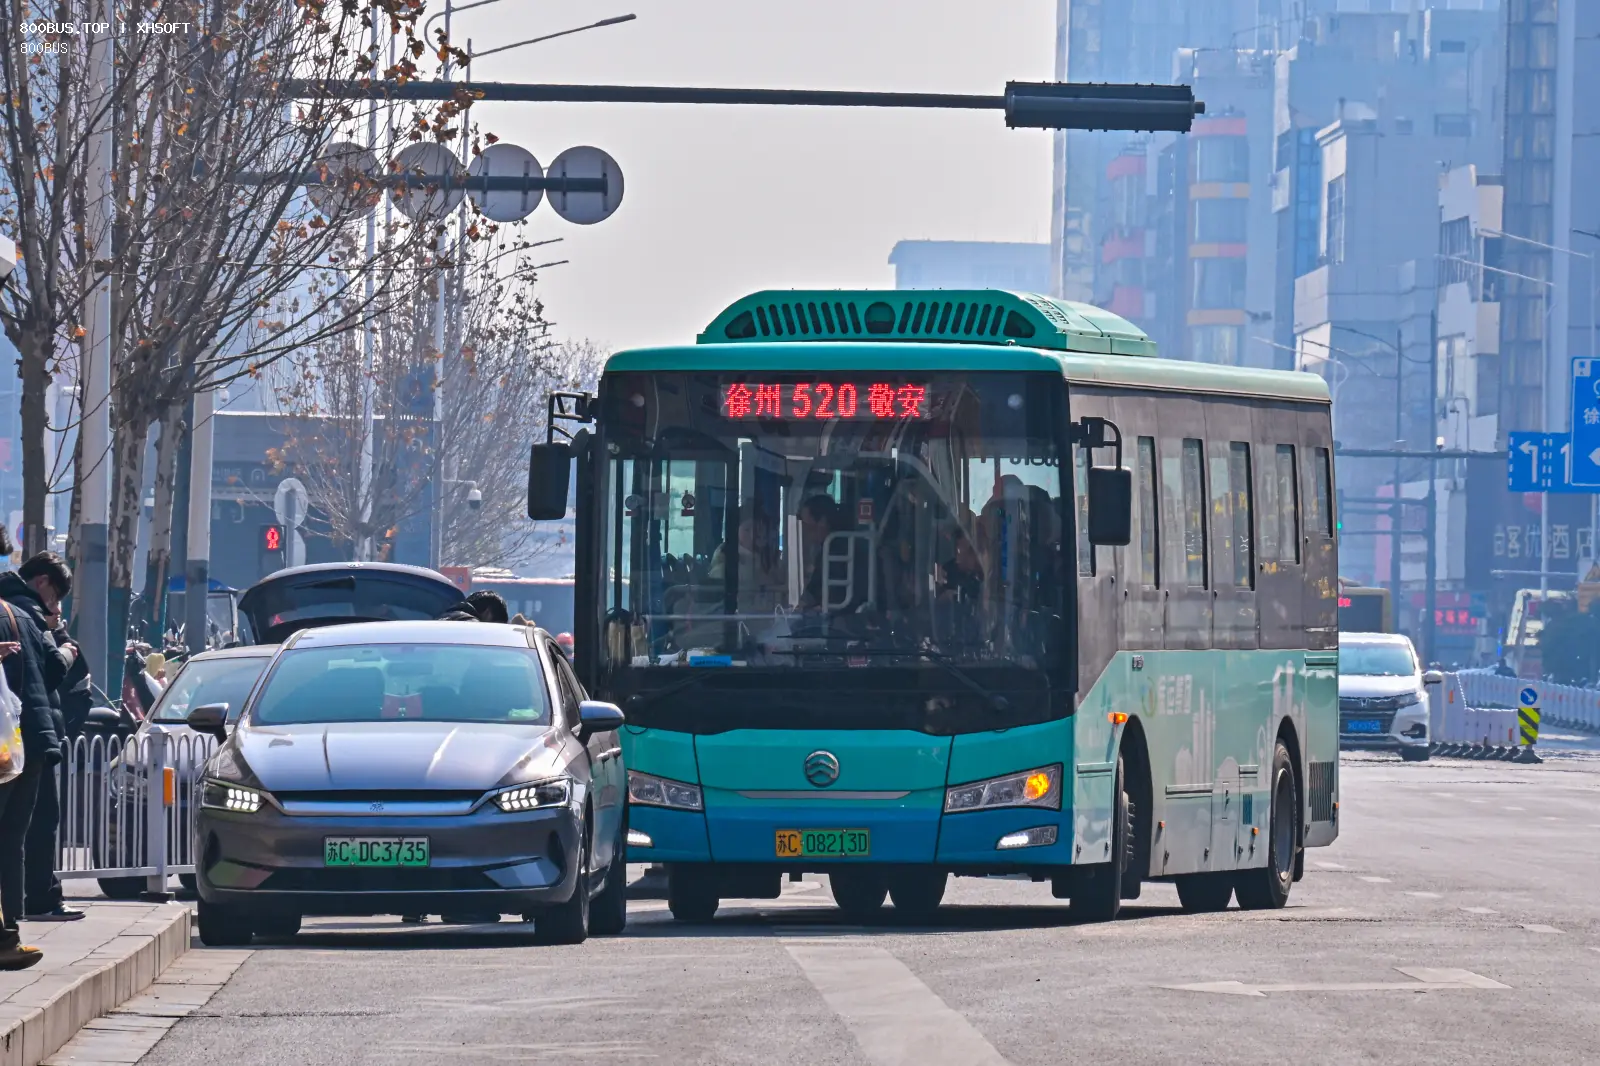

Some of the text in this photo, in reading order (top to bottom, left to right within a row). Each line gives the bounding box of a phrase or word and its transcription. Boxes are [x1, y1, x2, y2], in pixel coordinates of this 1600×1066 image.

[724, 383, 925, 418] 徐州 520 敬安
